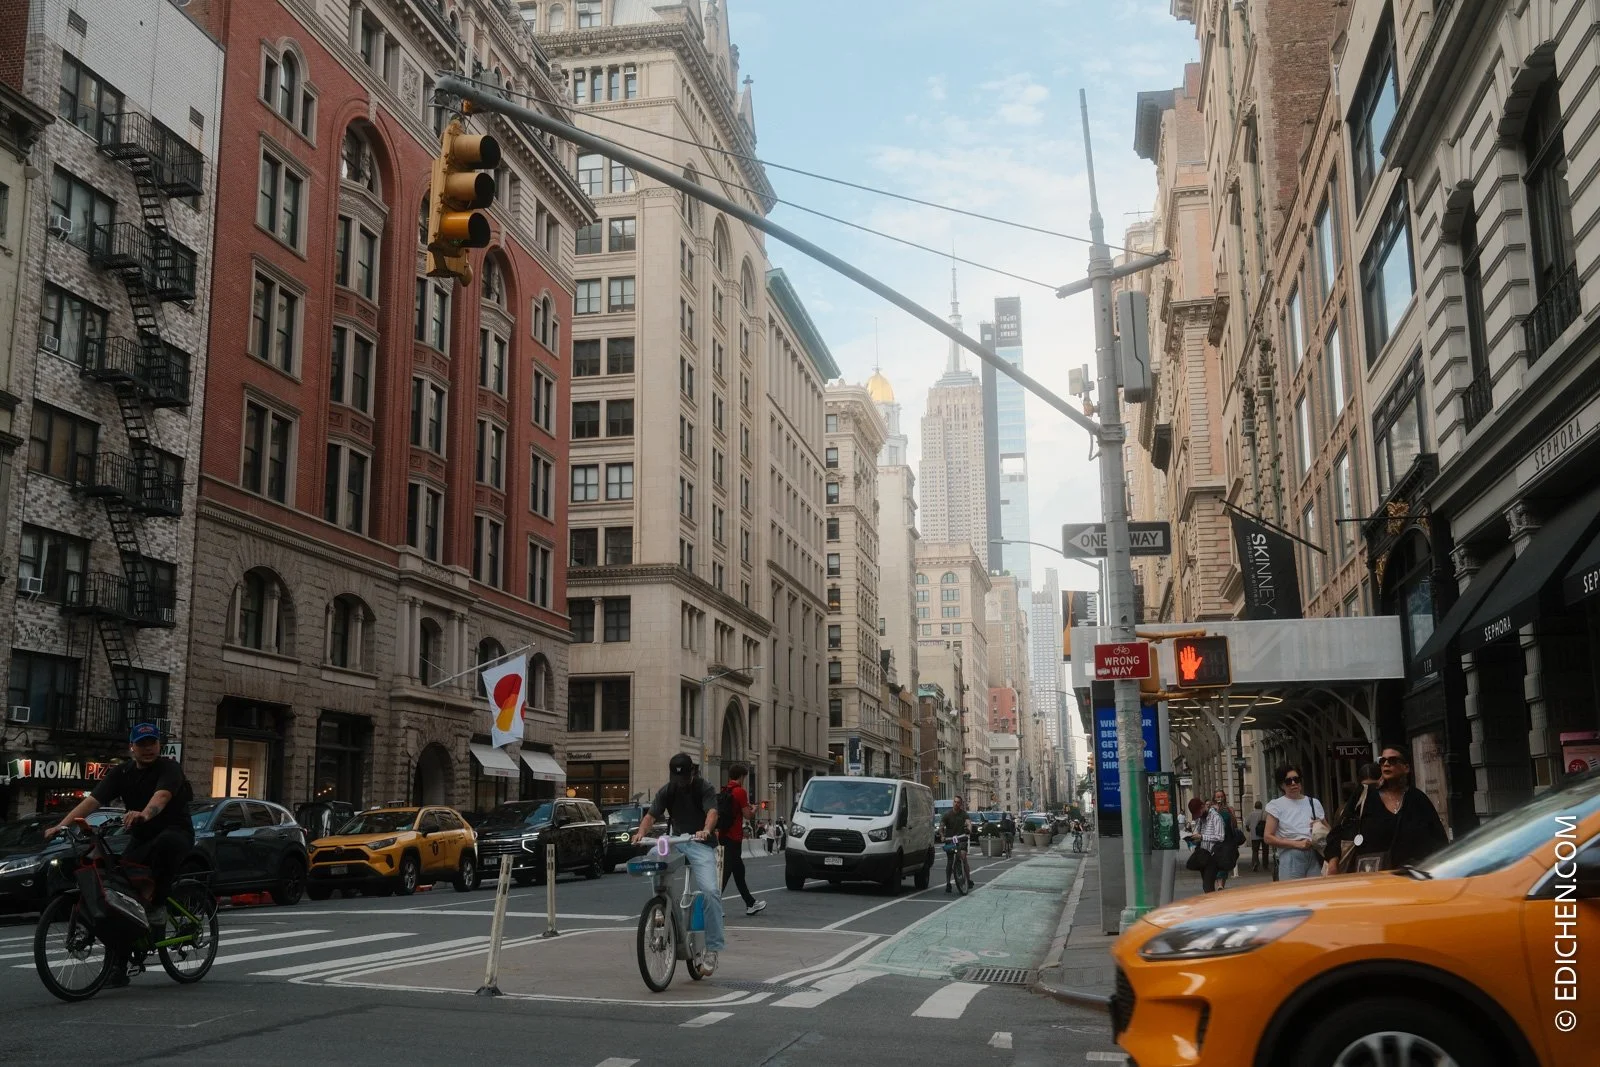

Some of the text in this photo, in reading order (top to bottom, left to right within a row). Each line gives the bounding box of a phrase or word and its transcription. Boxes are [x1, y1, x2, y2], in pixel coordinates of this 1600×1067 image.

[1534, 417, 1582, 471] SEPHORA
[1080, 532, 1159, 547] ONE WAY
[1251, 533, 1276, 611] SKINNEY
[1584, 568, 1600, 593] SEP
[1484, 616, 1512, 642] SEPHORA
[1104, 655, 1140, 666] WRONG
[1111, 666, 1133, 676] WAY
[160, 745, 176, 755] MA
[1102, 751, 1114, 759] SO
[34, 760, 117, 780] ROMA PIZ
